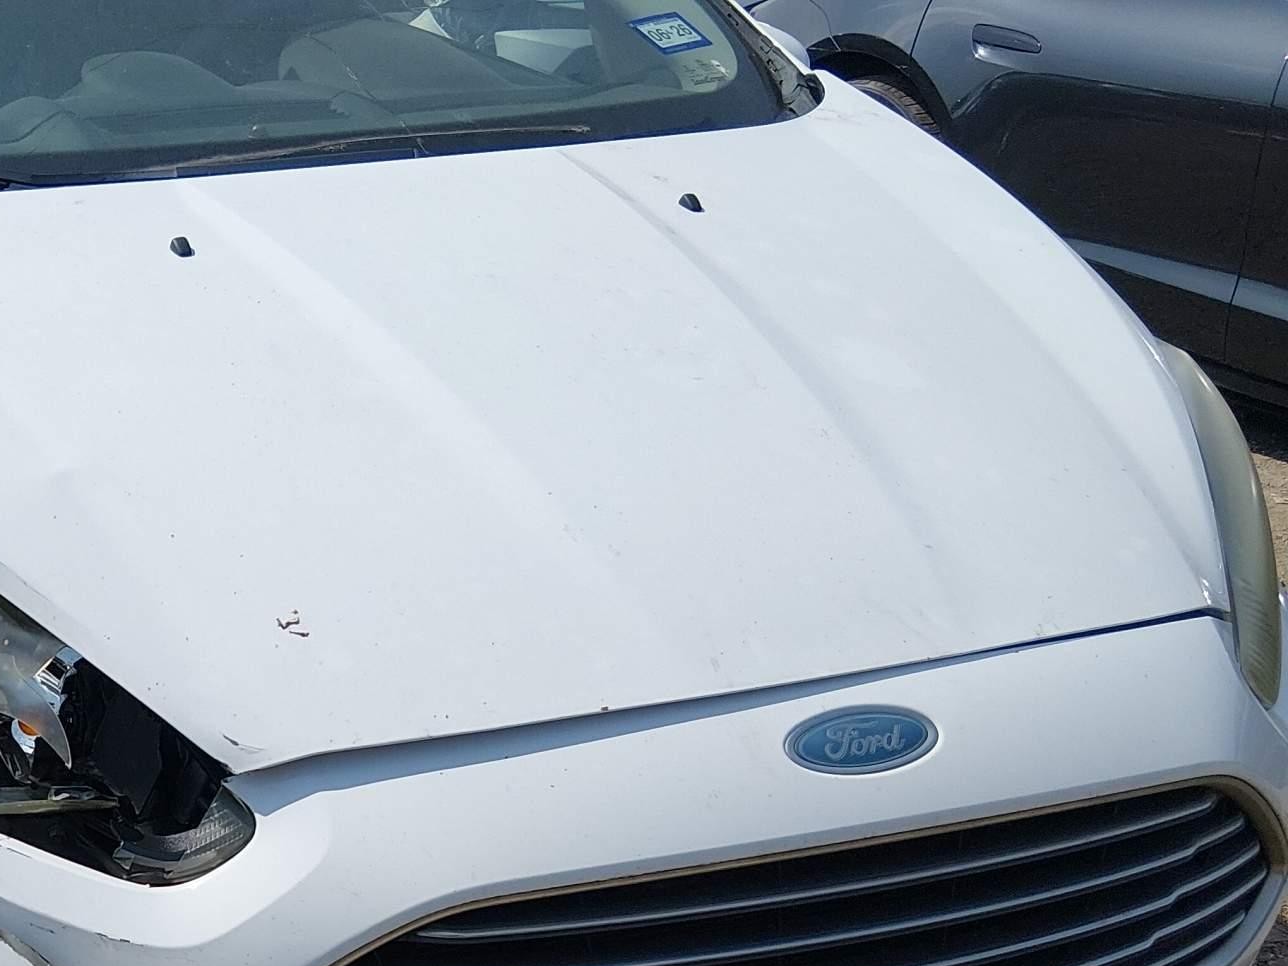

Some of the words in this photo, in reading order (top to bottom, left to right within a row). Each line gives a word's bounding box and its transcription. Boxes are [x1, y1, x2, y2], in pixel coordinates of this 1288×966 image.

[647, 29, 672, 42] 06
[669, 23, 693, 37] 26
[824, 719, 907, 762] Ford
